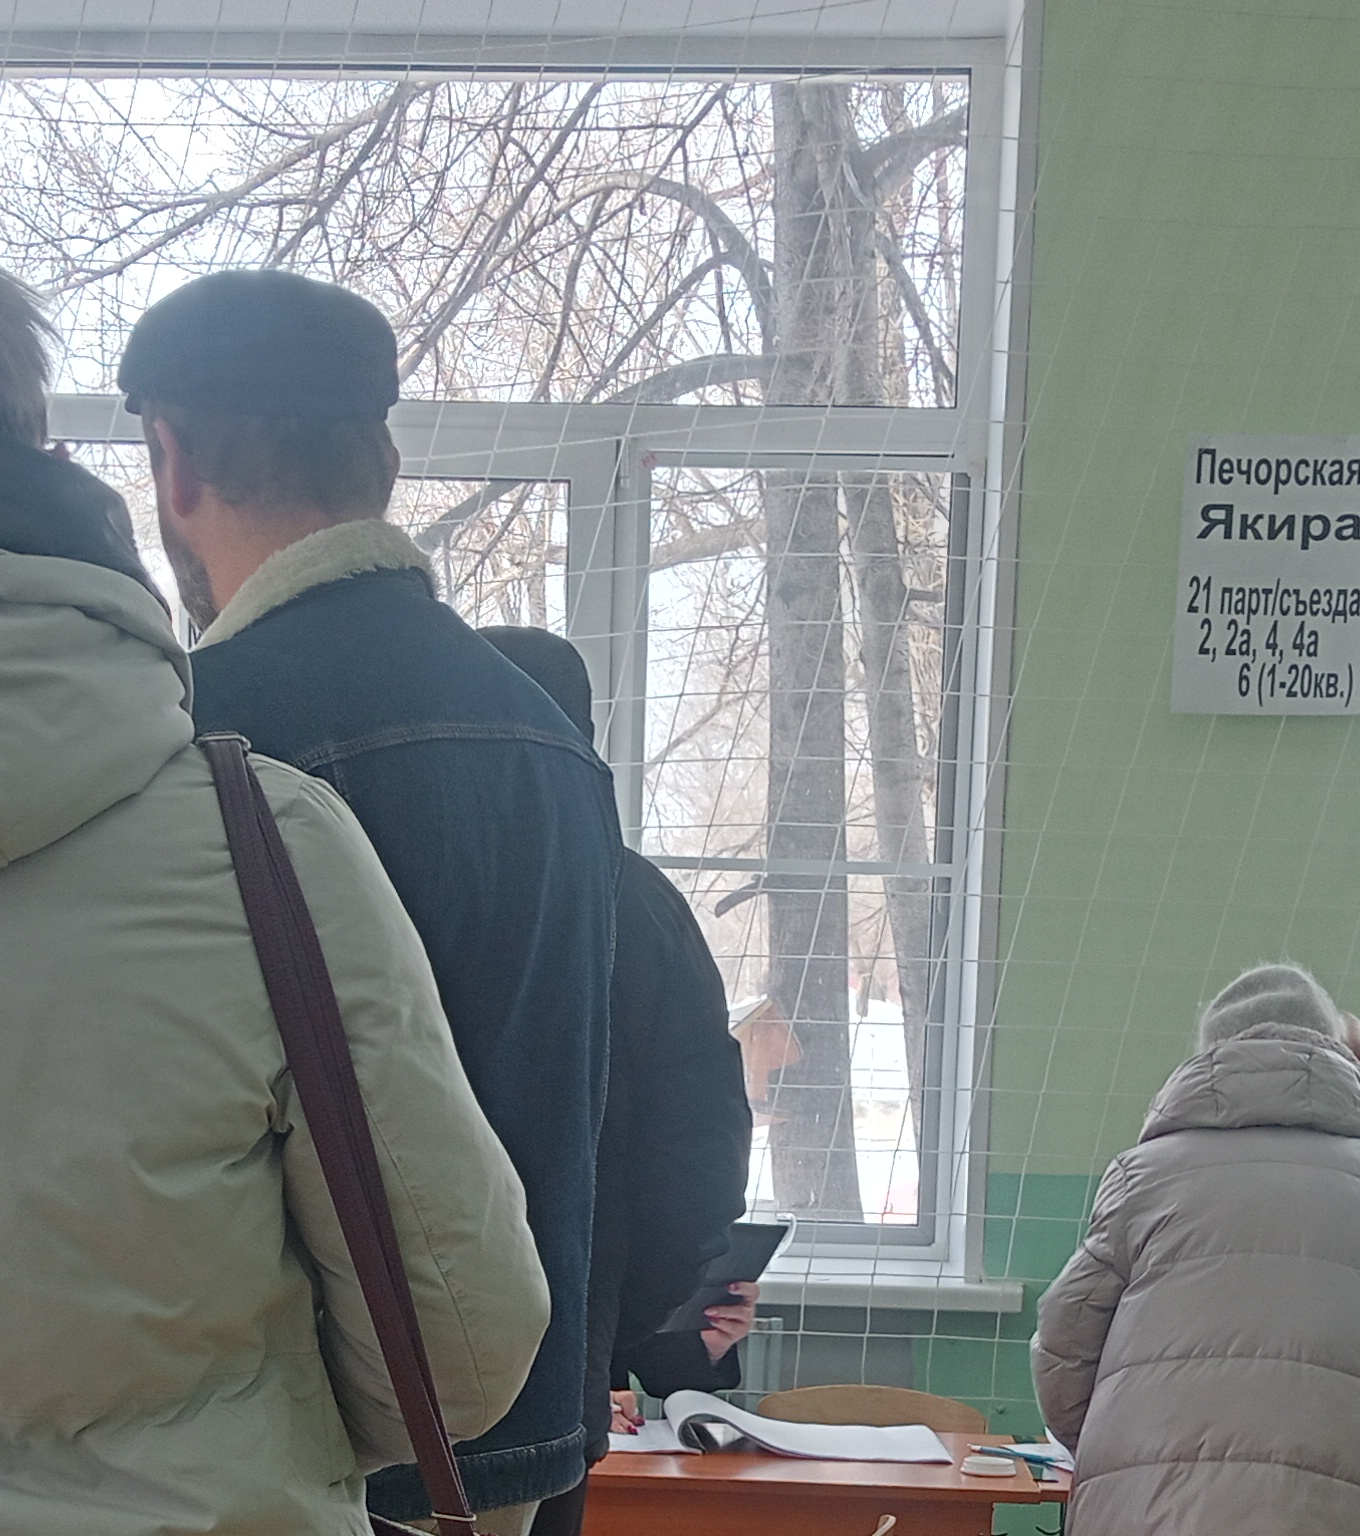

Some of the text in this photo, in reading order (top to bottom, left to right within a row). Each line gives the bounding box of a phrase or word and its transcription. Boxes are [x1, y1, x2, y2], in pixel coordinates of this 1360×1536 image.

[1196, 504, 1360, 550] Якира
[1187, 576, 1360, 625] 21 парт/съезда
[1198, 618, 1319, 664] 2, 2а, 4, 4а
[1238, 662, 1353, 707] 6 (1-20кв.)
